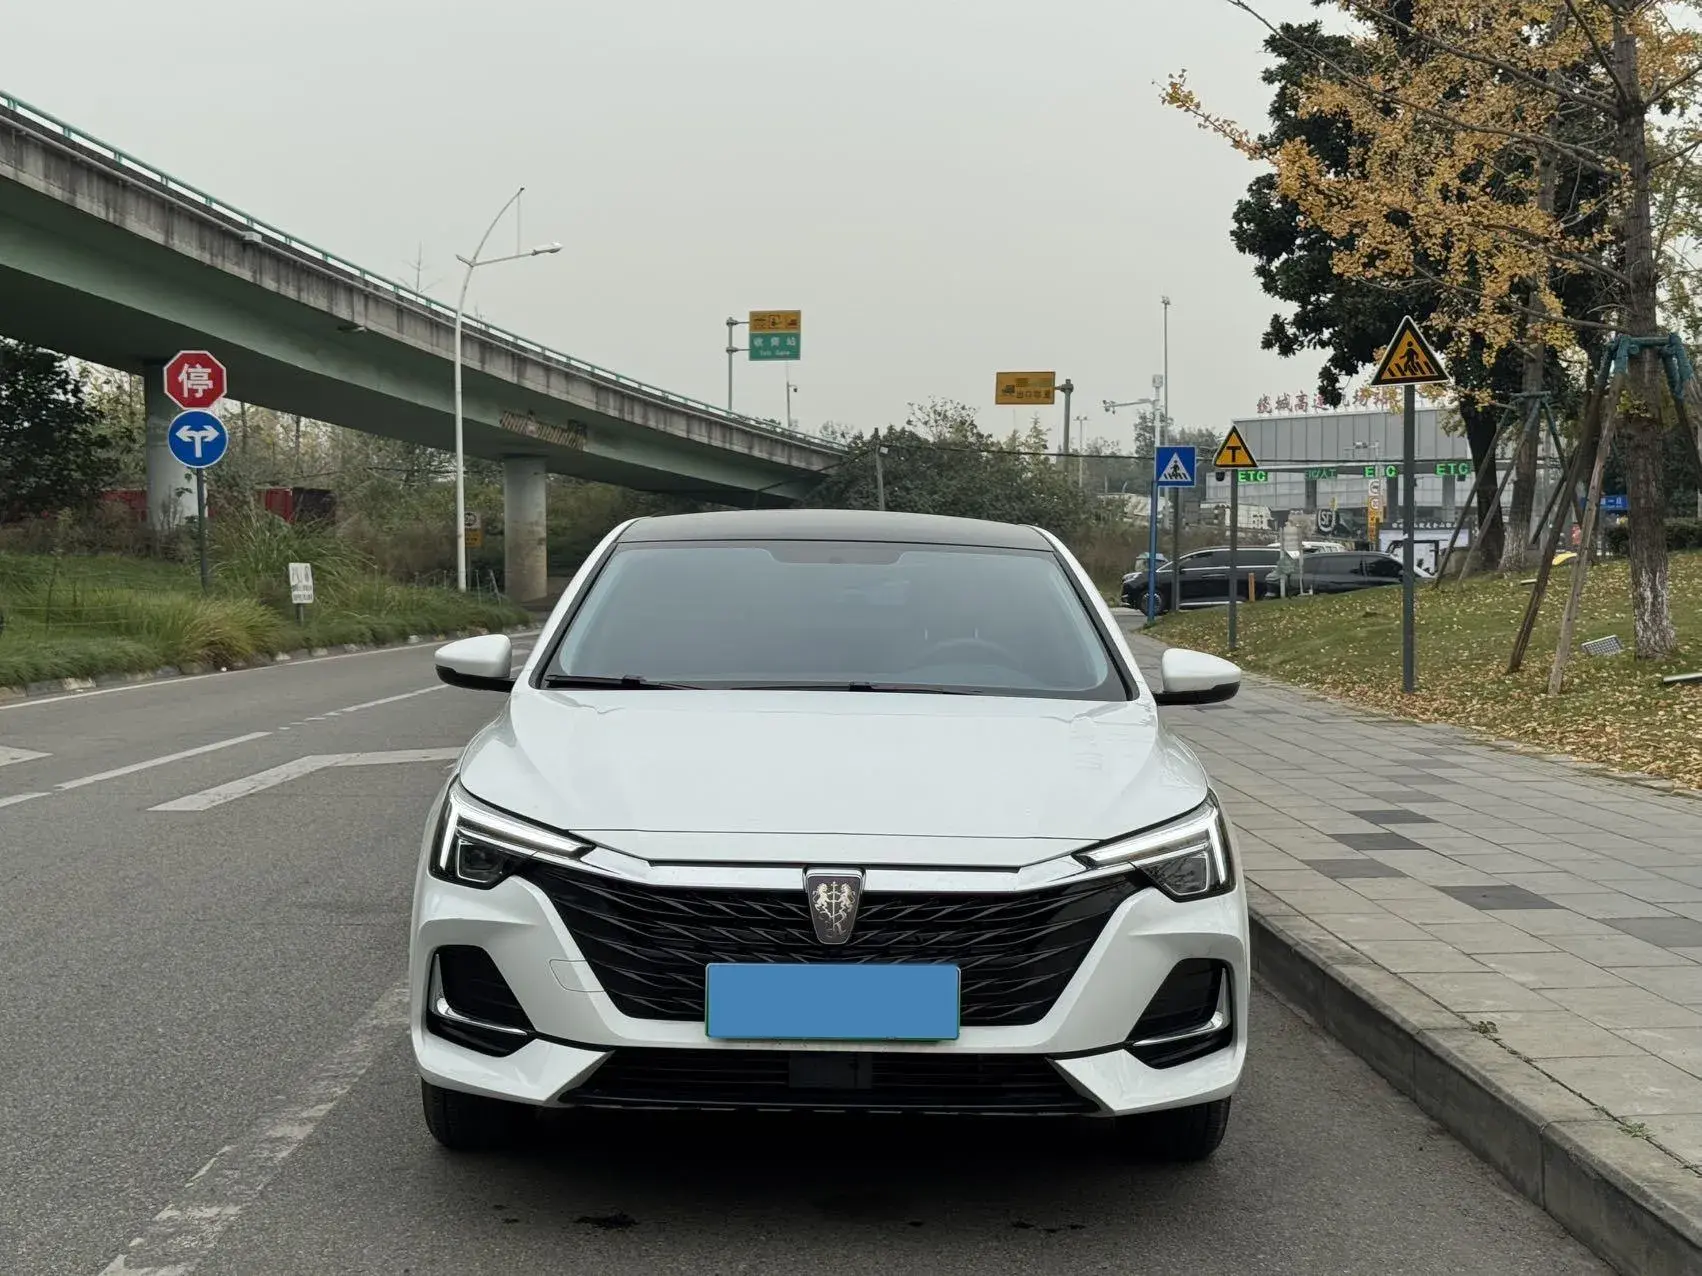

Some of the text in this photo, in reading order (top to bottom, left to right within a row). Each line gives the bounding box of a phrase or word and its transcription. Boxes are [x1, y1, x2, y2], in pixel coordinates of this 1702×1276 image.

[178, 363, 213, 398] 停
[1364, 464, 1397, 478] EC
[1435, 463, 1469, 476] ETC
[1238, 471, 1266, 482] ETC
